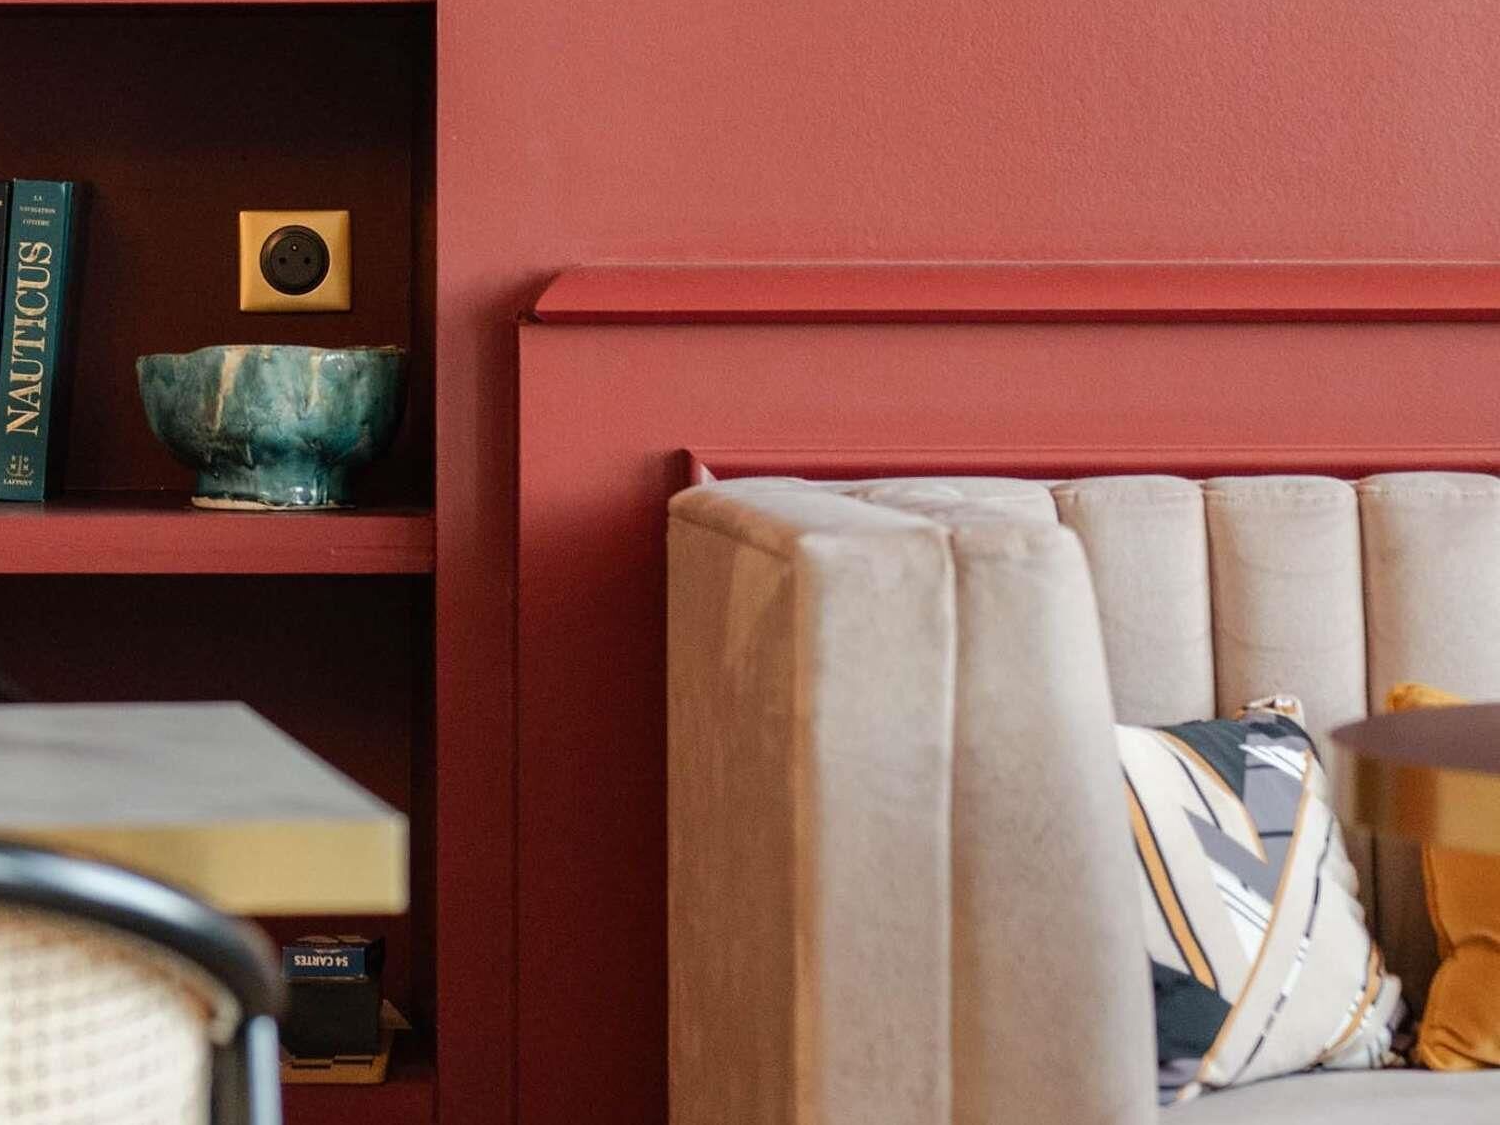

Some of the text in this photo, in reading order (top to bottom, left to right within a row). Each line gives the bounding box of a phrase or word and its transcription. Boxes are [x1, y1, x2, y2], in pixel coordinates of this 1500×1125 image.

[6, 241, 52, 437] NAUTICUS
[293, 955, 349, 967] 54 CARTES
